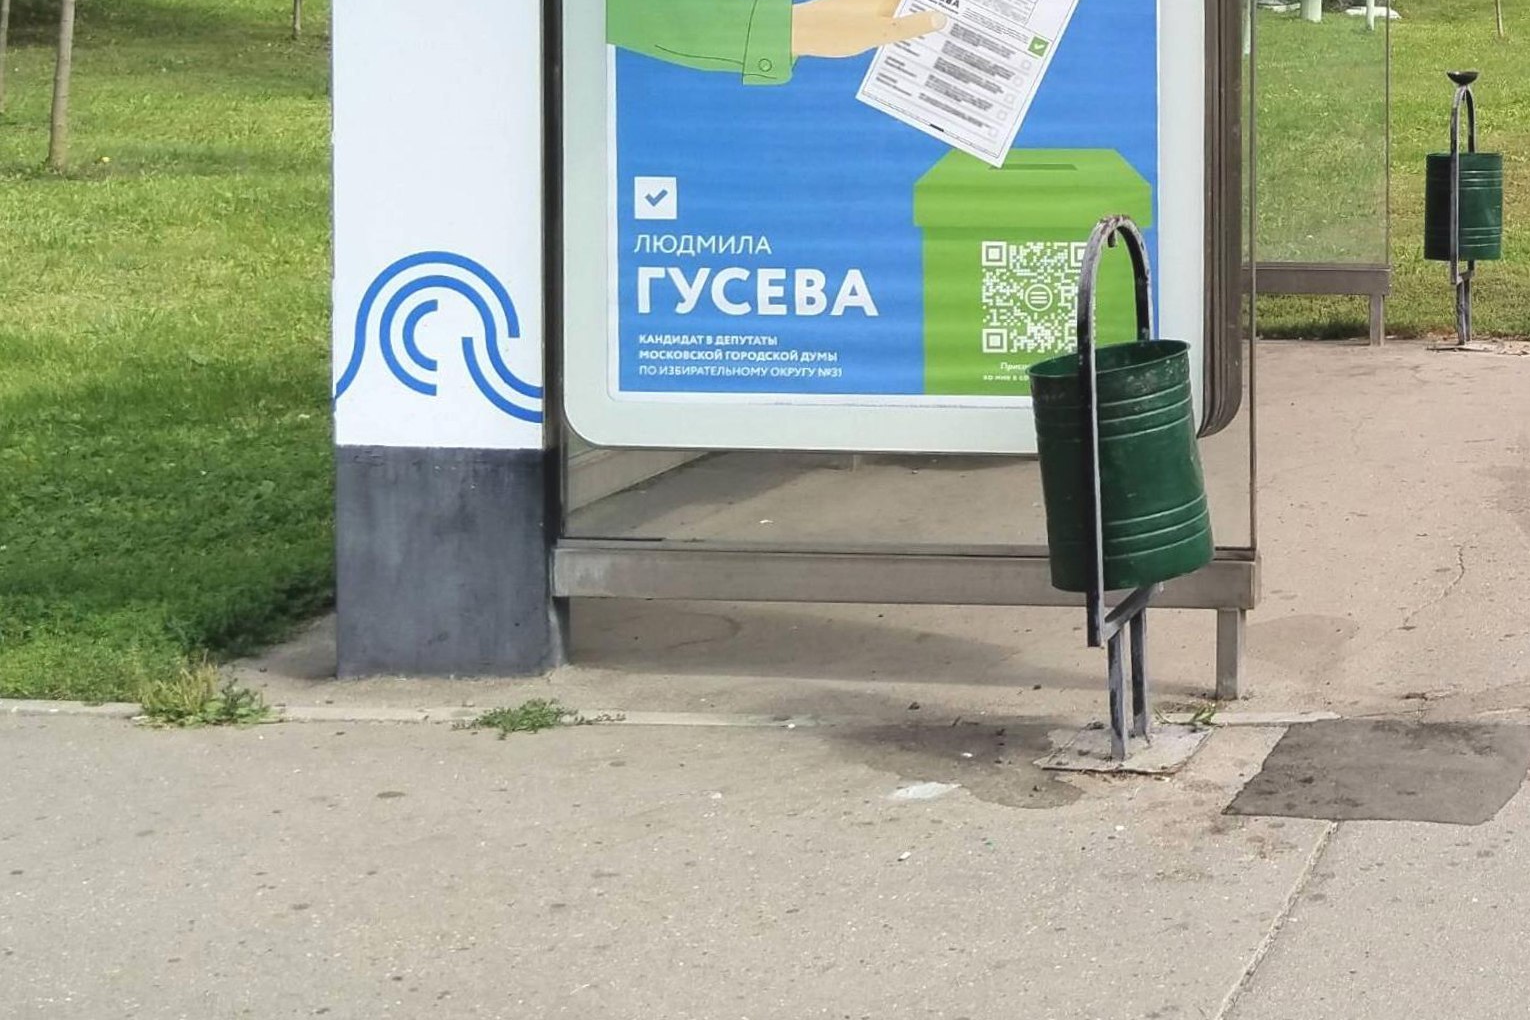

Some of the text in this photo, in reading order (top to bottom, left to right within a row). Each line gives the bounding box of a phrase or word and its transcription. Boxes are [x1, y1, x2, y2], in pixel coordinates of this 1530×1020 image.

[634, 235, 772, 257] ЛЮДМИЛА
[637, 266, 880, 317] ГУСЕВА
[639, 335, 778, 346] КАНДИДАТ В ДЕПУТАТЫ
[639, 348, 838, 363] МОСКОВСКОЙ ГОРОДСКОЙ ДУМЫ
[639, 365, 657, 376] ПО
[659, 365, 769, 377] ИЗБИРАТЕЛЬНОМУ
[770, 366, 818, 377] ОКРУГУ
